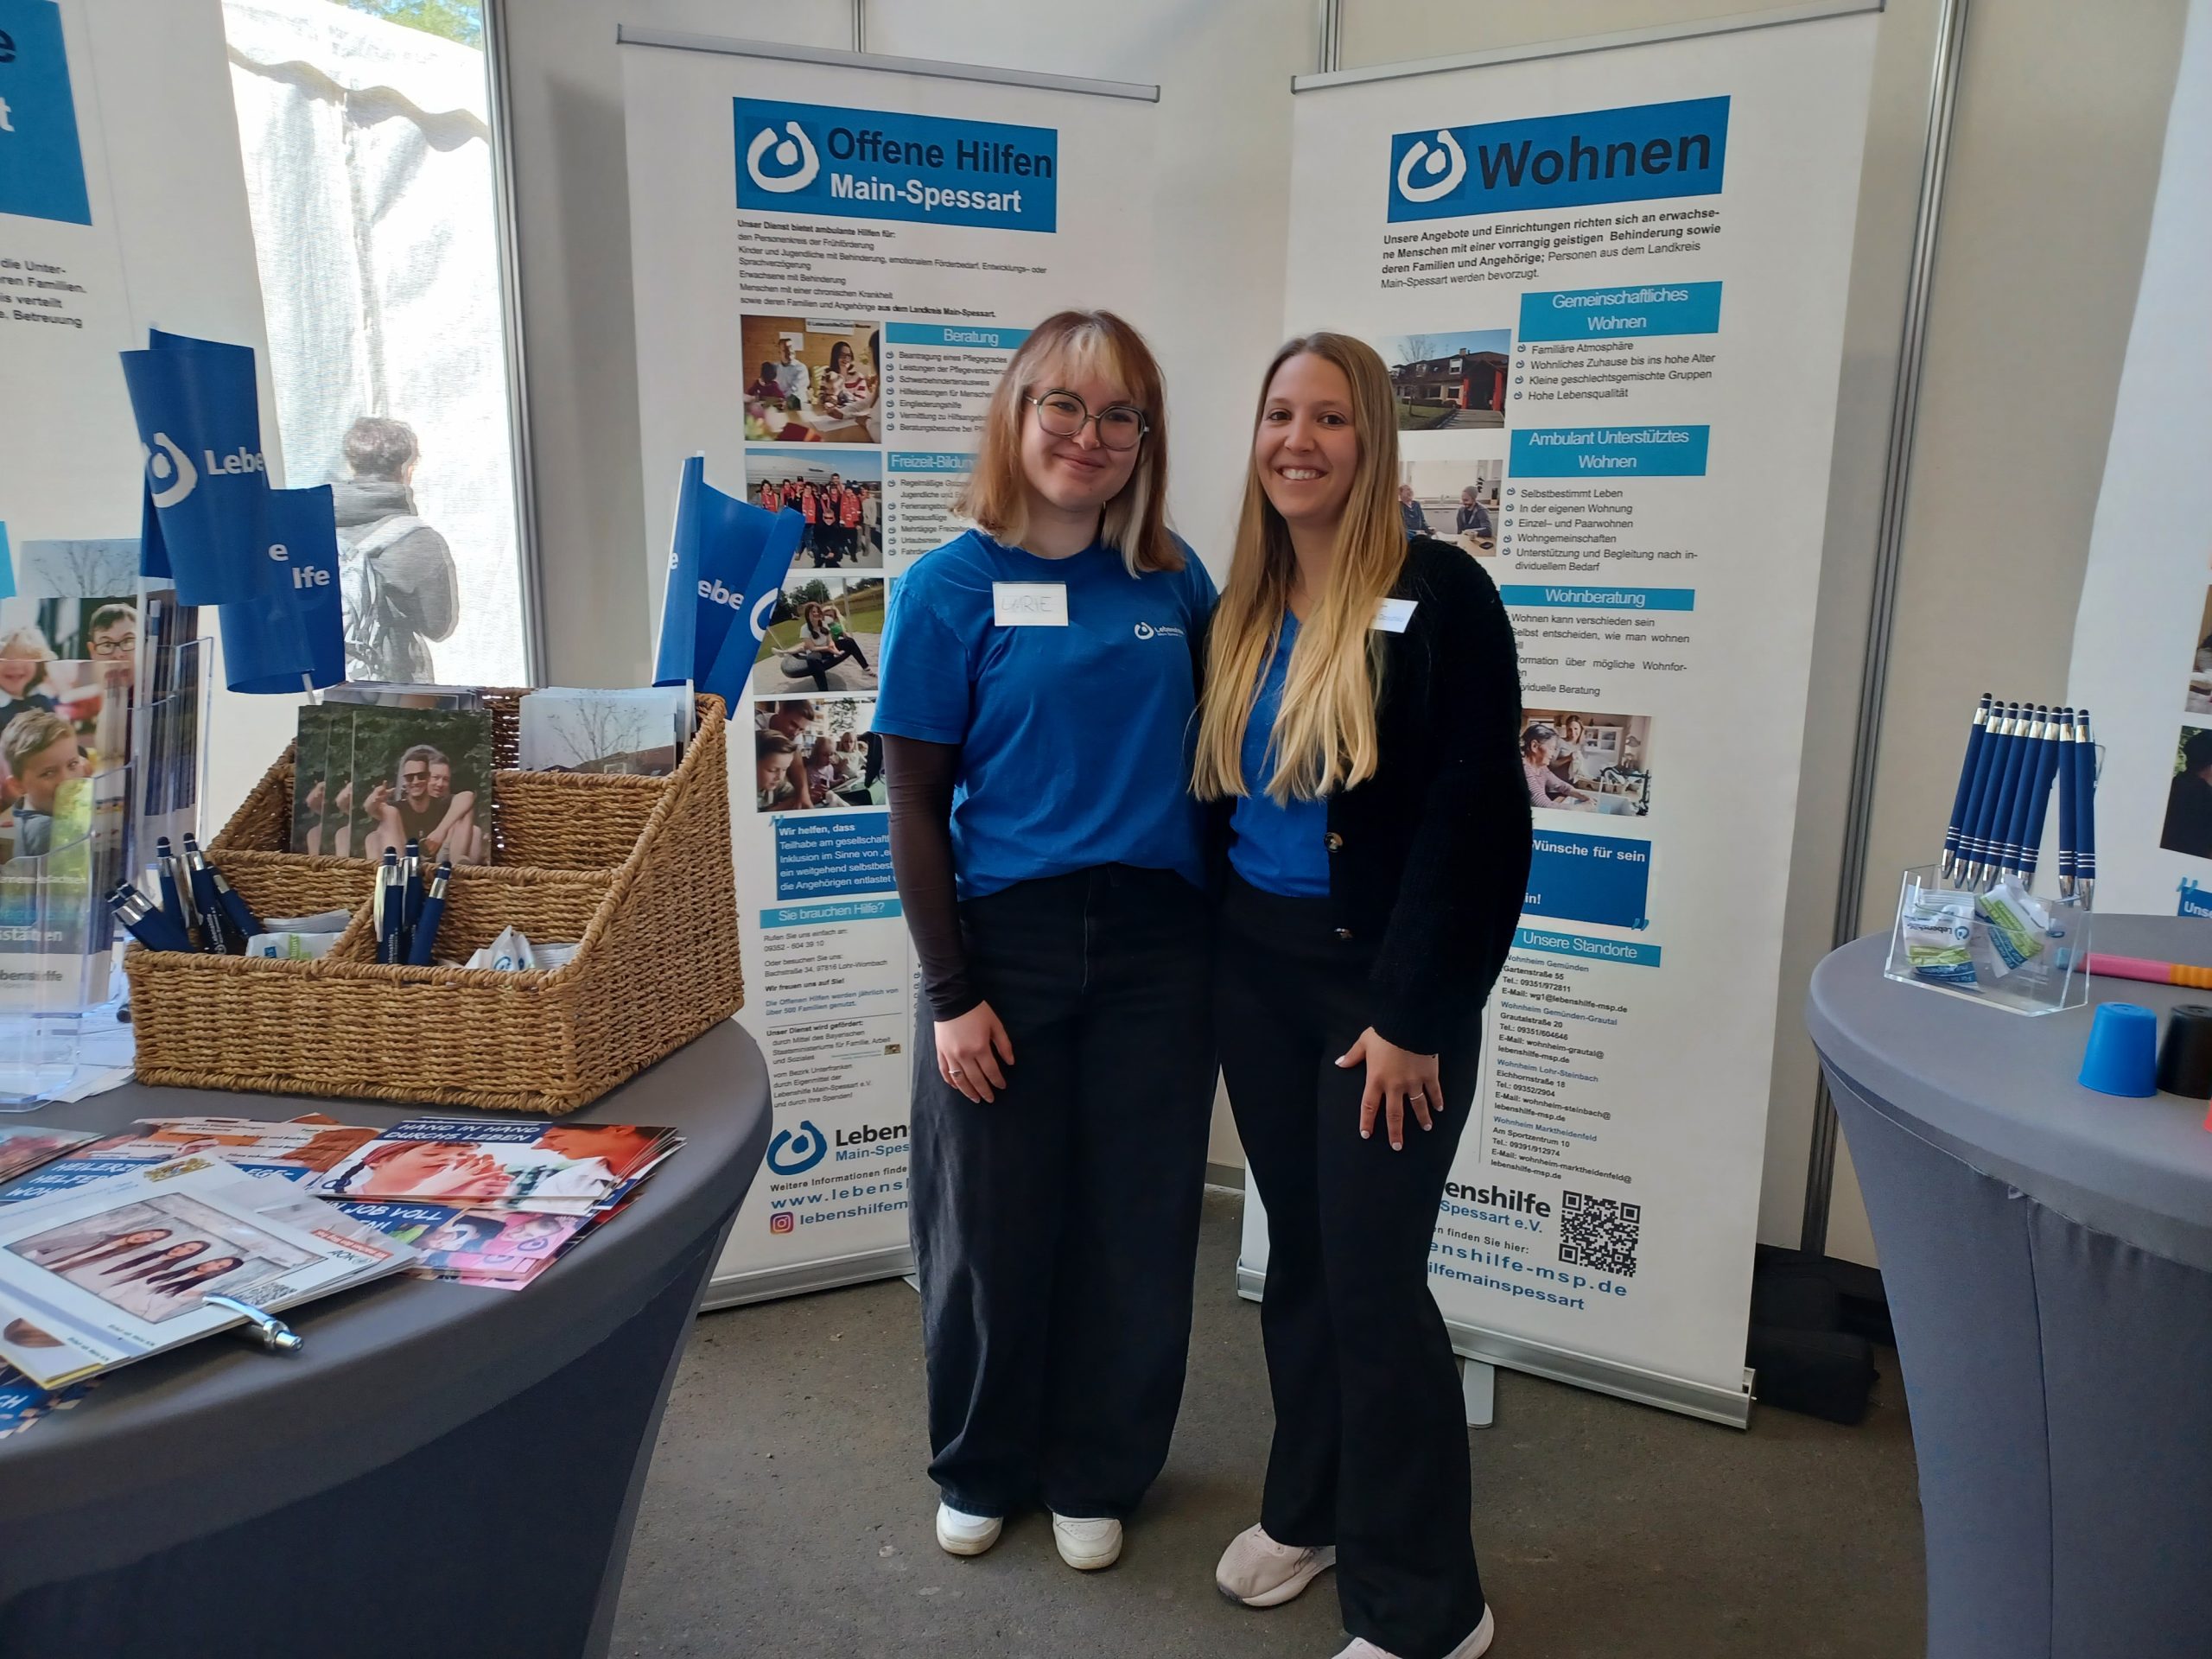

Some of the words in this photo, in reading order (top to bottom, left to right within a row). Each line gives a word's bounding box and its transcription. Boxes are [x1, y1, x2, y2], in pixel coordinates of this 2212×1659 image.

[827, 129, 944, 167] Offene
[957, 140, 1052, 176] Hilfen
[1478, 133, 1710, 189] Wohnen
[831, 173, 1021, 213] Main-Spessart
[1383, 234, 1419, 244] Unsere
[1421, 230, 1469, 242] Angebote
[1471, 226, 1491, 236] und
[1495, 222, 1570, 234] Einrichtungen
[1573, 218, 1611, 228] richten
[1614, 213, 1638, 225] sich
[1658, 209, 1719, 220] erwachse-
[1397, 246, 1448, 257] Menschen
[1451, 244, 1467, 253] mit
[1469, 242, 1496, 251] einer
[1498, 237, 1550, 249] vorrangig
[1553, 234, 1603, 247] geistigen
[1610, 228, 1683, 240] Behinderung
[1686, 224, 1721, 235] sowie
[1382, 264, 1409, 273] deren
[1412, 260, 1455, 270] Familien
[1457, 257, 1478, 268] und
[1478, 253, 1544, 266] Angehörige;
[1548, 251, 1597, 260] Personen
[1599, 249, 1618, 257] aus
[1621, 246, 1644, 255] dem
[1648, 241, 1700, 253] Landkreis
[1381, 276, 1447, 288] Main-Spessart
[1450, 273, 1484, 283] werden
[1487, 269, 1539, 280] bevorzugt.
[1552, 289, 1688, 308] Gemeinschaftliches
[1587, 316, 1647, 330] Wohnen
[944, 328, 999, 346] Beratung
[1531, 344, 1574, 354] Familiäre
[1576, 341, 1634, 352] Atmosphäre
[1530, 359, 1584, 369] Wohnliches
[1586, 358, 1628, 367] Zuhause
[1630, 356, 1644, 365] bis
[1663, 354, 1689, 364] hohe
[1690, 353, 1716, 363] Alter
[1529, 376, 1558, 385] Kleine
[1560, 372, 1665, 385] geschlechtsgemischte
[1668, 370, 1712, 380] Gruppen
[1528, 391, 1554, 400] Hohe
[1556, 388, 1628, 399] Lebensqualität
[1529, 432, 1594, 445] Ambulant
[1597, 429, 1689, 443] Unterstütztes
[1578, 454, 1637, 467] Wohnen
[1520, 489, 1591, 498] Selbstbestimmt
[1593, 489, 1623, 498] Leben
[1519, 504, 1529, 512] In
[1530, 504, 1547, 512] der
[1548, 505, 1585, 514] eigenen
[1587, 504, 1633, 515] Wohnung
[1554, 518, 1572, 527] und
[1574, 518, 1633, 528] Paarwohnen
[1516, 533, 1617, 543] Wohngemeinschaften
[1516, 548, 1580, 559] Unterstützung
[1582, 549, 1600, 557] und
[1603, 549, 1654, 560] Begleitung
[1656, 550, 1681, 559] nach
[1684, 550, 1698, 559] in-
[1515, 562, 1567, 570] dividuellem
[1568, 562, 1600, 571] Bedarf
[292, 566, 330, 589] lfe
[697, 579, 744, 611] ebe
[1545, 589, 1645, 607] Wohnberatung
[1511, 613, 1548, 622] Wohnen
[1551, 614, 1573, 623] kann
[1575, 616, 1632, 626] verschieden
[1634, 618, 1655, 626] sein
[1604, 632, 1621, 640] wie
[1650, 633, 1689, 643] wohnen
[1518, 655, 1559, 665] ormation
[1565, 657, 1586, 666] über
[1592, 658, 1635, 670] mögliche
[1642, 661, 1687, 671] Wohnfor-
[1558, 684, 1600, 696] Beratung
[779, 827, 796, 836] Wir
[798, 825, 830, 834] helfen,
[832, 823, 855, 832] dass
[779, 840, 817, 849] Teilhabe
[779, 854, 819, 862] Inklusion
[834, 850, 861, 859] Sinne
[1592, 846, 1612, 858] für
[1617, 850, 1645, 861] sein
[795, 864, 847, 875] weitgehend
[795, 879, 852, 890] Angehörigen
[853, 874, 891, 884] entlastet
[1525, 892, 1541, 904] in!
[779, 910, 798, 921] Sie
[798, 906, 852, 918] brauchen
[854, 901, 885, 913] Hilfe?
[2184, 900, 2212, 918] Uns
[1523, 931, 1570, 949] Unsere
[1573, 938, 1637, 957] Standorte
[1503, 965, 1554, 978] Gartenstraße
[1546, 960, 1589, 972] Gemünden
[1502, 987, 1528, 996] E-Mail:
[384, 1131, 462, 1140] DURCHS
[461, 1132, 532, 1141] LEBEN
[836, 1125, 907, 1146] Leben
[836, 1144, 910, 1160] Main-Spes
[770, 1181, 808, 1192] Weitere
[811, 1171, 880, 1185] Informationen
[882, 1166, 907, 1175] finde
[771, 1178, 910, 1209] www.lebens
[1445, 1181, 1551, 1217] enshilfe
[344, 1204, 391, 1216] JOB
[389, 1207, 442, 1221] VOLL
[800, 1201, 908, 1224] lebenshilfem
[1440, 1199, 1510, 1225] Spessart
[1514, 1219, 1541, 1232] e.V.
[1446, 1228, 1479, 1242] finden
[1483, 1236, 1500, 1247] Sie
[1503, 1241, 1529, 1254] hier:
[1430, 1242, 1627, 1296] enshilfe-msp.de
[1428, 1262, 1585, 1310] ilfemainspessart
